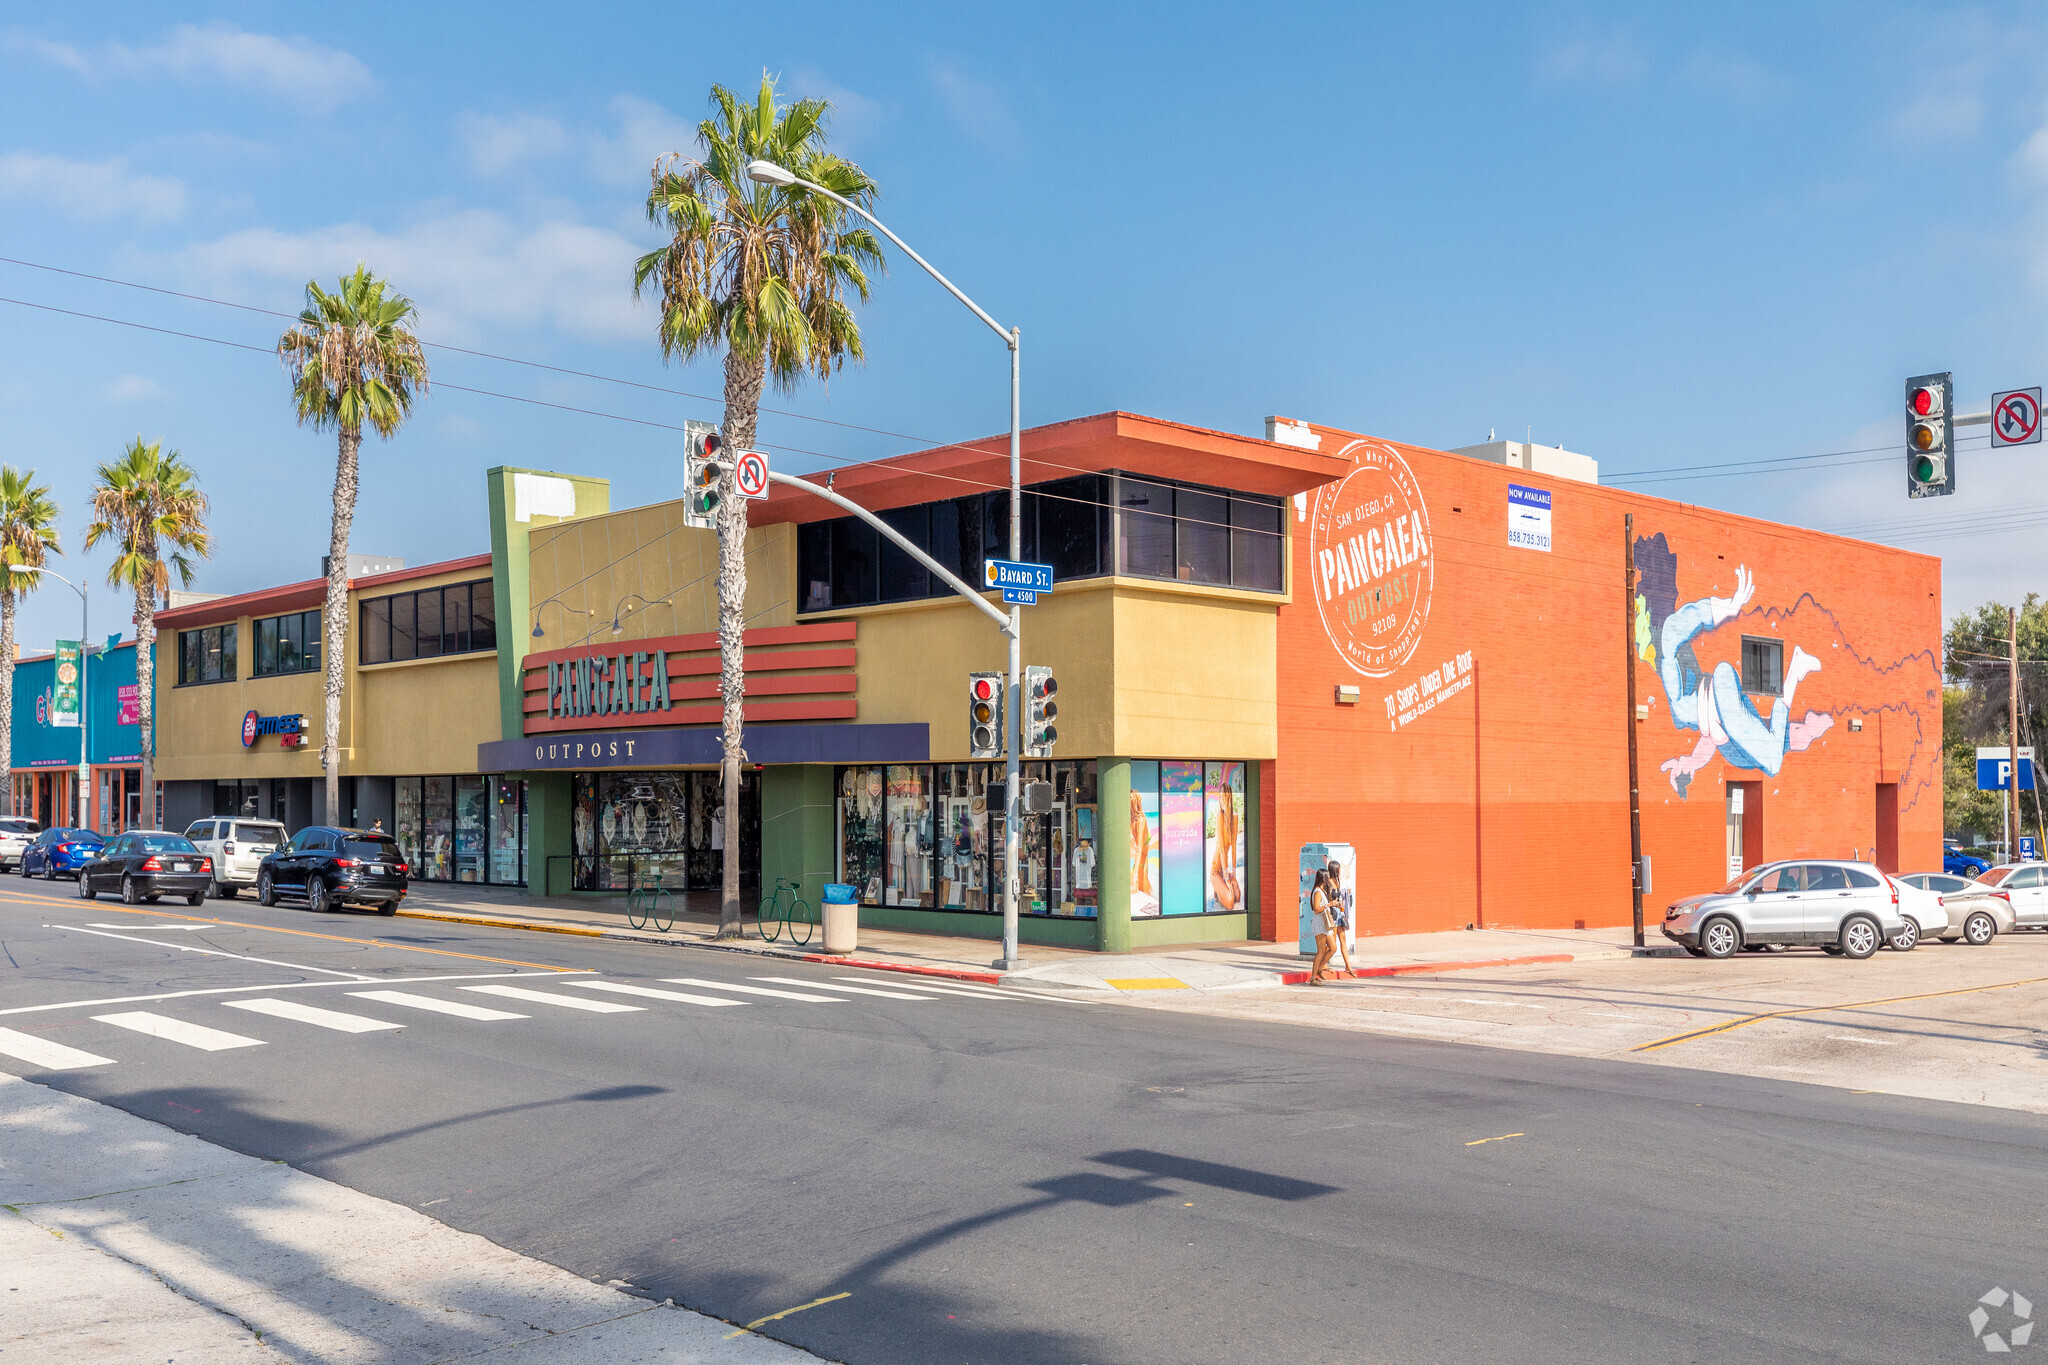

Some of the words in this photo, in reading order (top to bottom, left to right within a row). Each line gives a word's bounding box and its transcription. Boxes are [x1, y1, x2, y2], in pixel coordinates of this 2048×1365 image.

[1355, 455, 1360, 464] a
[1366, 450, 1394, 470] Whole
[1398, 471, 1413, 497] New
[1508, 487, 1524, 499] NOW
[1524, 491, 1551, 505] AVAILABLE
[1336, 510, 1352, 530] SAN
[1508, 530, 1550, 548] 858.735.3121
[1318, 509, 1428, 602] PANGAEA
[1000, 566, 1033, 585] BAYARD
[1036, 570, 1049, 586] ST.
[1017, 590, 1034, 602] 4500
[1347, 573, 1410, 626] OUTPOST
[1347, 640, 1371, 664] World
[1375, 653, 1385, 665] of
[1389, 609, 1421, 660] Shopping!
[1372, 613, 1396, 637] 92109
[547, 649, 672, 720] PANGAEA
[1383, 694, 1396, 719] 70
[1396, 682, 1420, 712] SHOPS
[1419, 669, 1442, 697] UNDER
[1442, 660, 1457, 684] ONE
[1455, 649, 1473, 676] ROOF
[1391, 719, 1397, 733] A
[1436, 674, 1472, 704] MARKETPLACE
[244, 718, 256, 736] 24
[256, 714, 300, 736] FITNESS
[535, 740, 635, 761] OUTPOST
[1997, 761, 2011, 785] P
